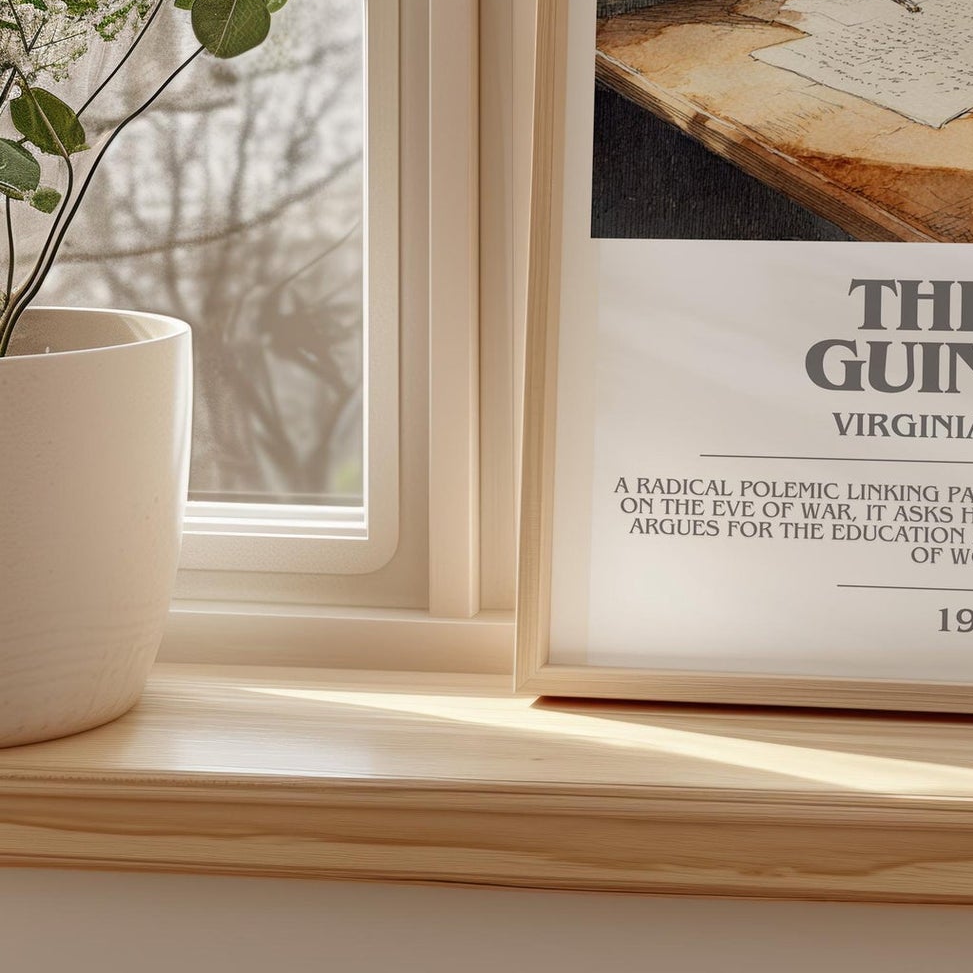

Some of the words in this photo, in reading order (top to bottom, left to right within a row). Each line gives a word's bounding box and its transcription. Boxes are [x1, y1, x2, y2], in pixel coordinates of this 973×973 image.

[613, 476, 630, 494] A
[635, 477, 734, 497] RADICAL
[739, 479, 841, 500] POLEMIC
[846, 483, 940, 503] LINKING
[619, 496, 655, 515] ON
[659, 498, 707, 517] THE
[711, 499, 757, 518] EVE
[761, 500, 795, 519] OF
[800, 501, 857, 523] WAR,
[865, 503, 888, 522] IT
[892, 505, 954, 526] ASKS
[628, 517, 721, 537] ARGUES
[727, 520, 774, 539] FOR
[778, 521, 825, 540] THE
[831, 523, 966, 545] EDUCATION
[910, 546, 944, 564] OF
